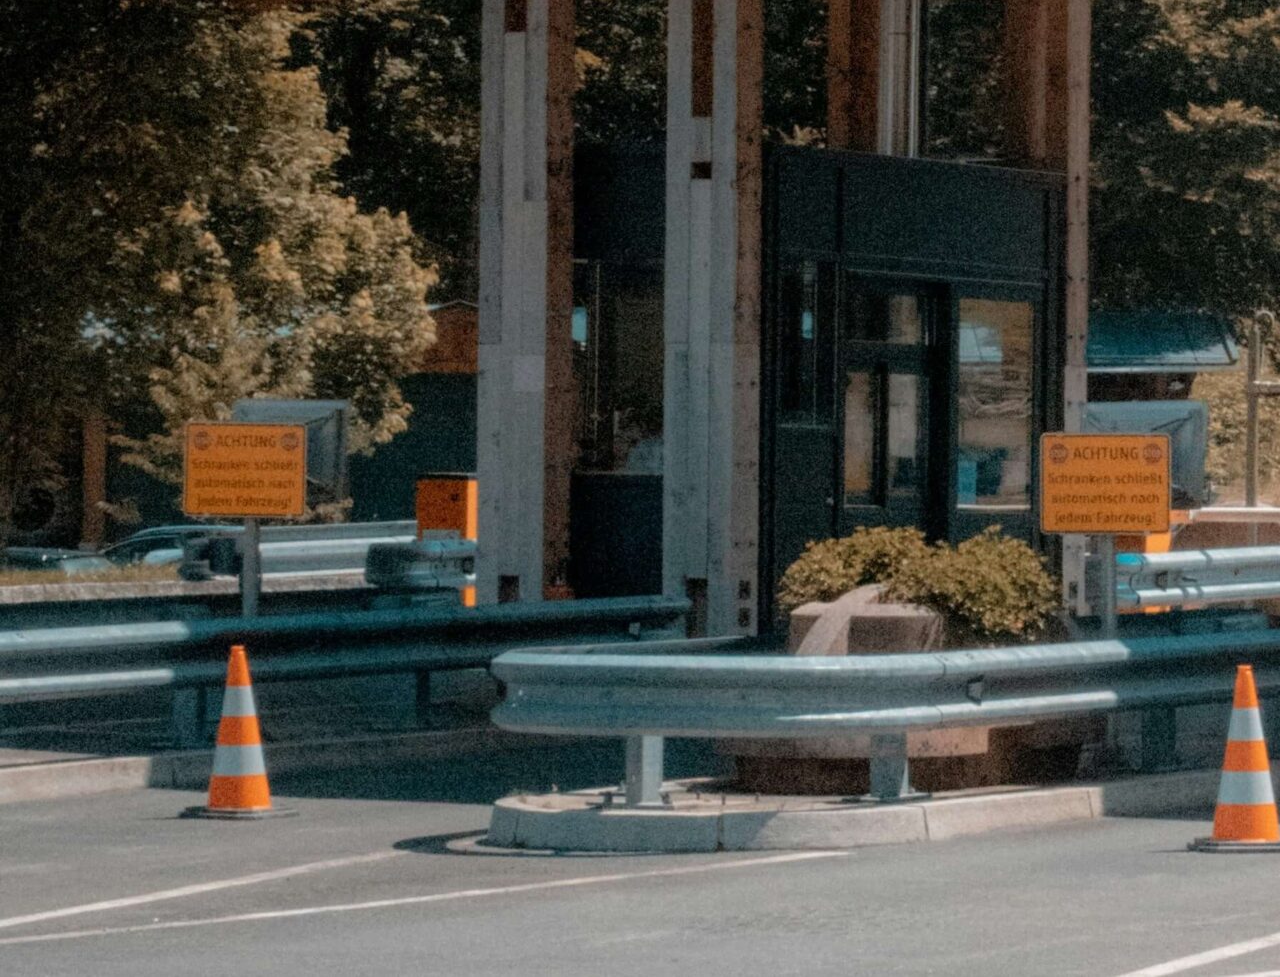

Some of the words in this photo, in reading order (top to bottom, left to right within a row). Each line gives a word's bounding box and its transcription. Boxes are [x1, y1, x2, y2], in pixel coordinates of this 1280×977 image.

[215, 435, 276, 448] ACHTUNG
[1073, 447, 1138, 460] ACHTUNG
[193, 478, 264, 488] automatisch
[1048, 474, 1111, 484] Schranken
[1113, 473, 1162, 484] schließt
[1052, 493, 1127, 504] automatisch
[1131, 494, 1159, 504] nach
[1055, 512, 1092, 525] jedem
